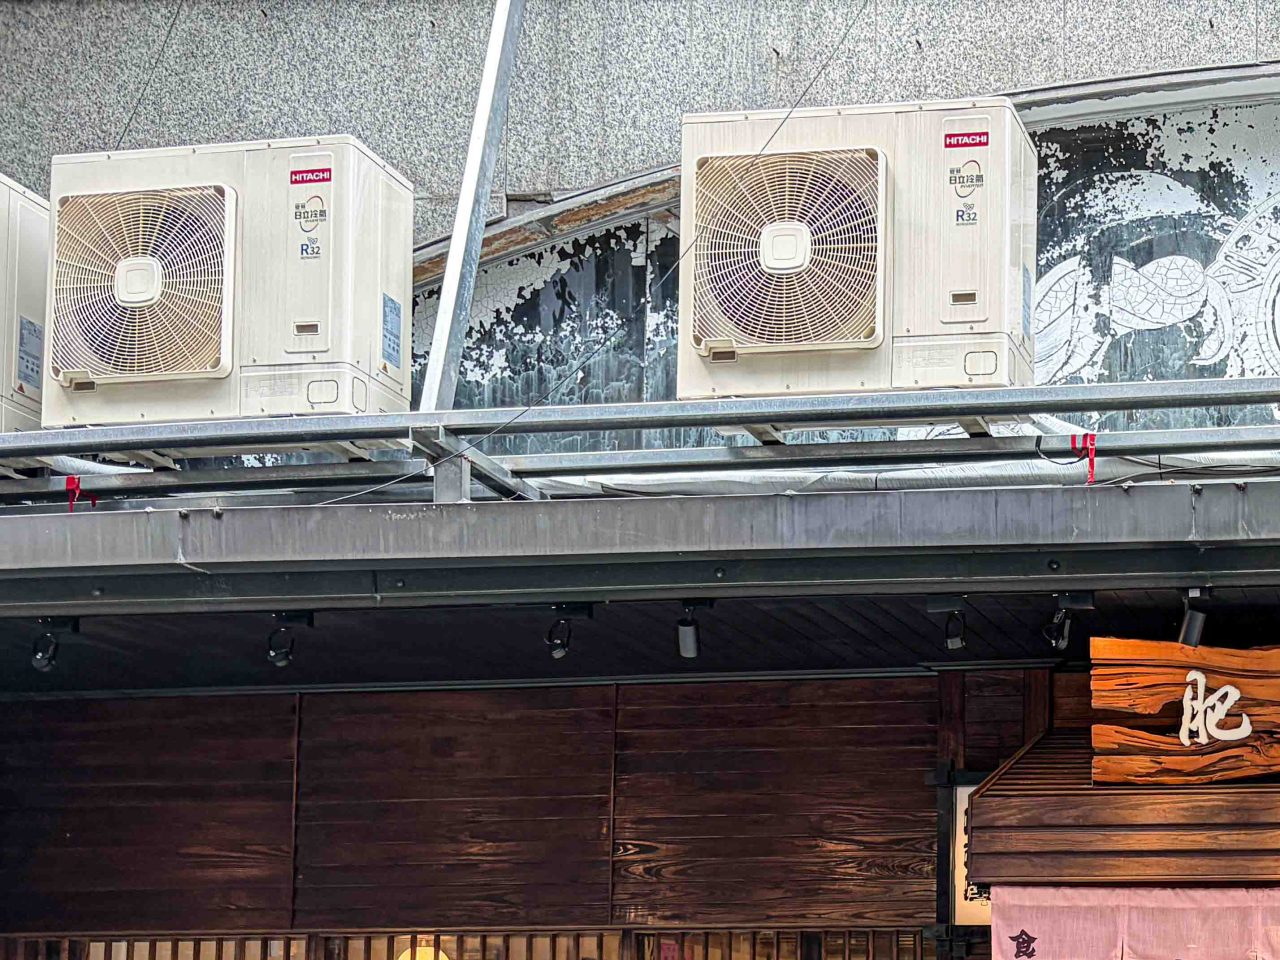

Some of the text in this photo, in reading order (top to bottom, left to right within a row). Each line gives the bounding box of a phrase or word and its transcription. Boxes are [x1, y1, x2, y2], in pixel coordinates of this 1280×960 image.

[946, 135, 988, 145] HITACHI
[292, 171, 330, 182] HITACHI
[949, 174, 984, 185] 日立冷氣
[956, 209, 978, 222] R32
[300, 243, 321, 256] R32
